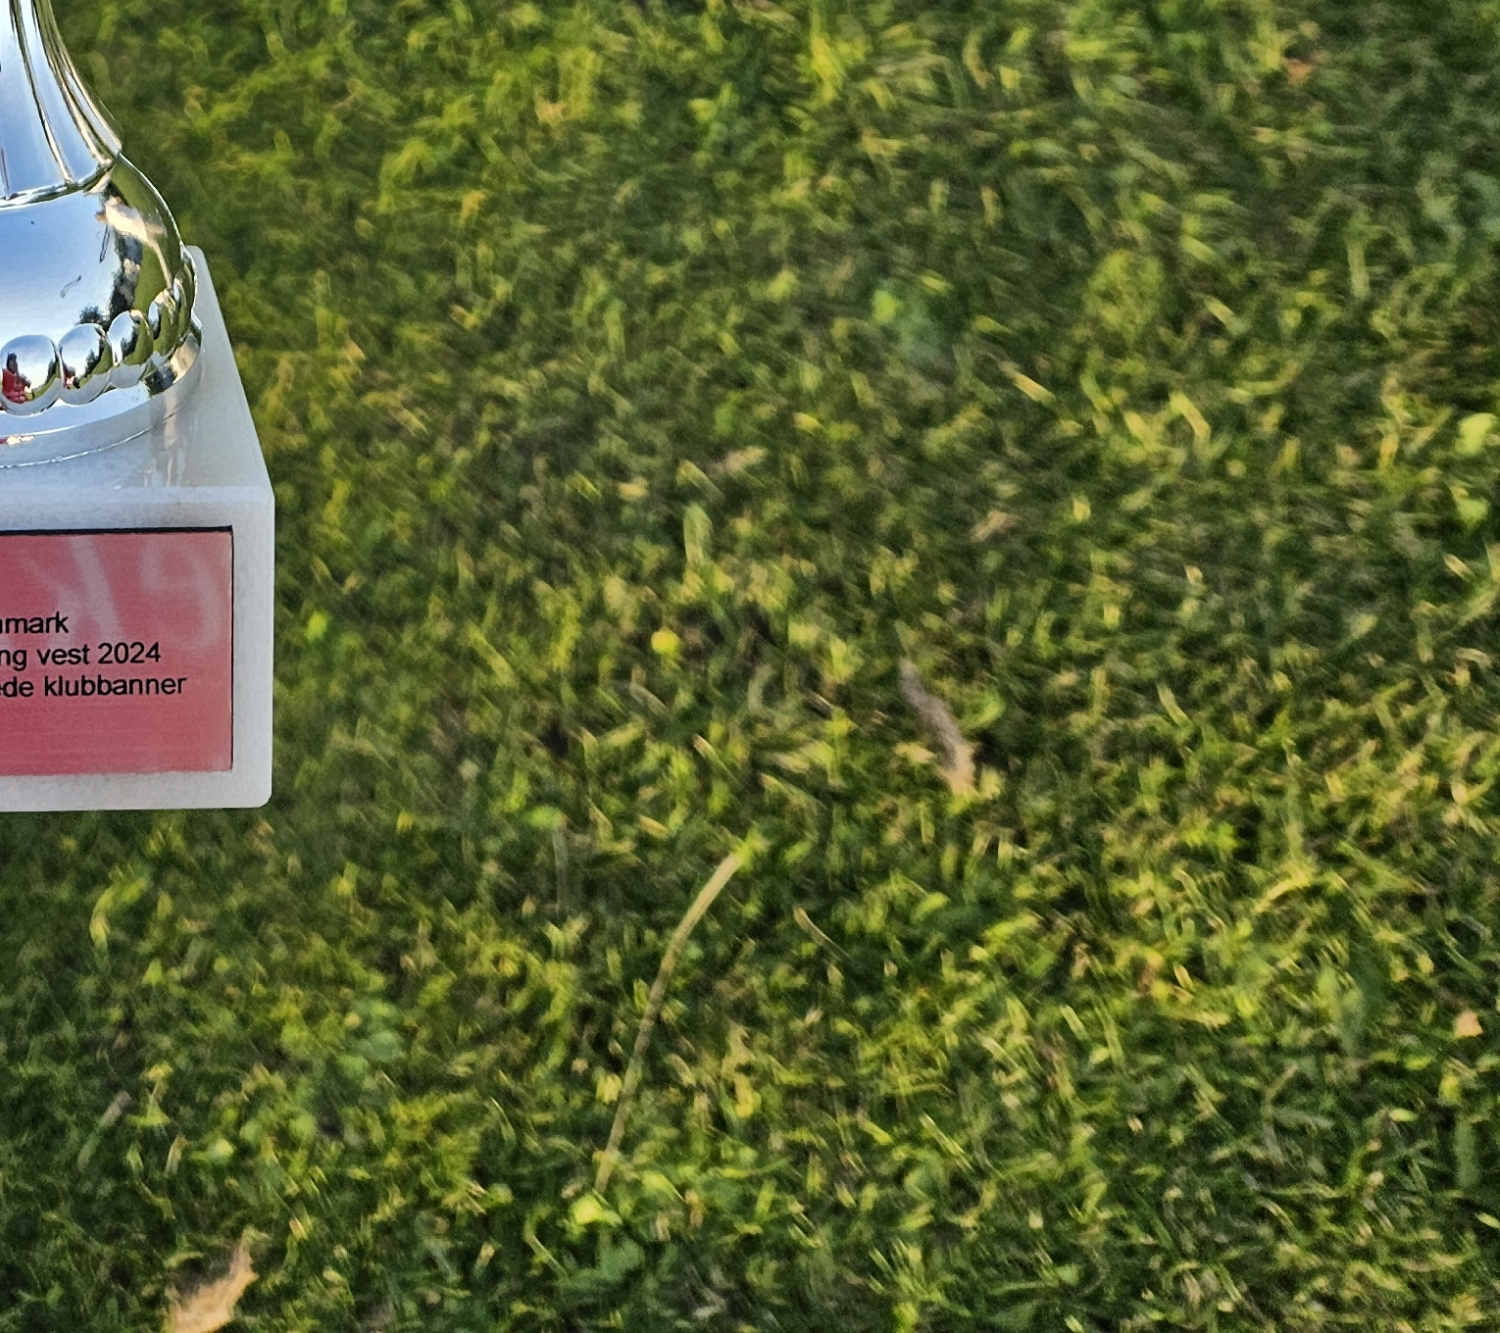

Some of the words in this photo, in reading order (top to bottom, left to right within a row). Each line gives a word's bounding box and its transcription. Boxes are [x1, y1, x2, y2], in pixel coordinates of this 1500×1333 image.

[36, 644, 91, 666] vest
[97, 641, 162, 665] 2024
[44, 674, 187, 697] klubbanner
